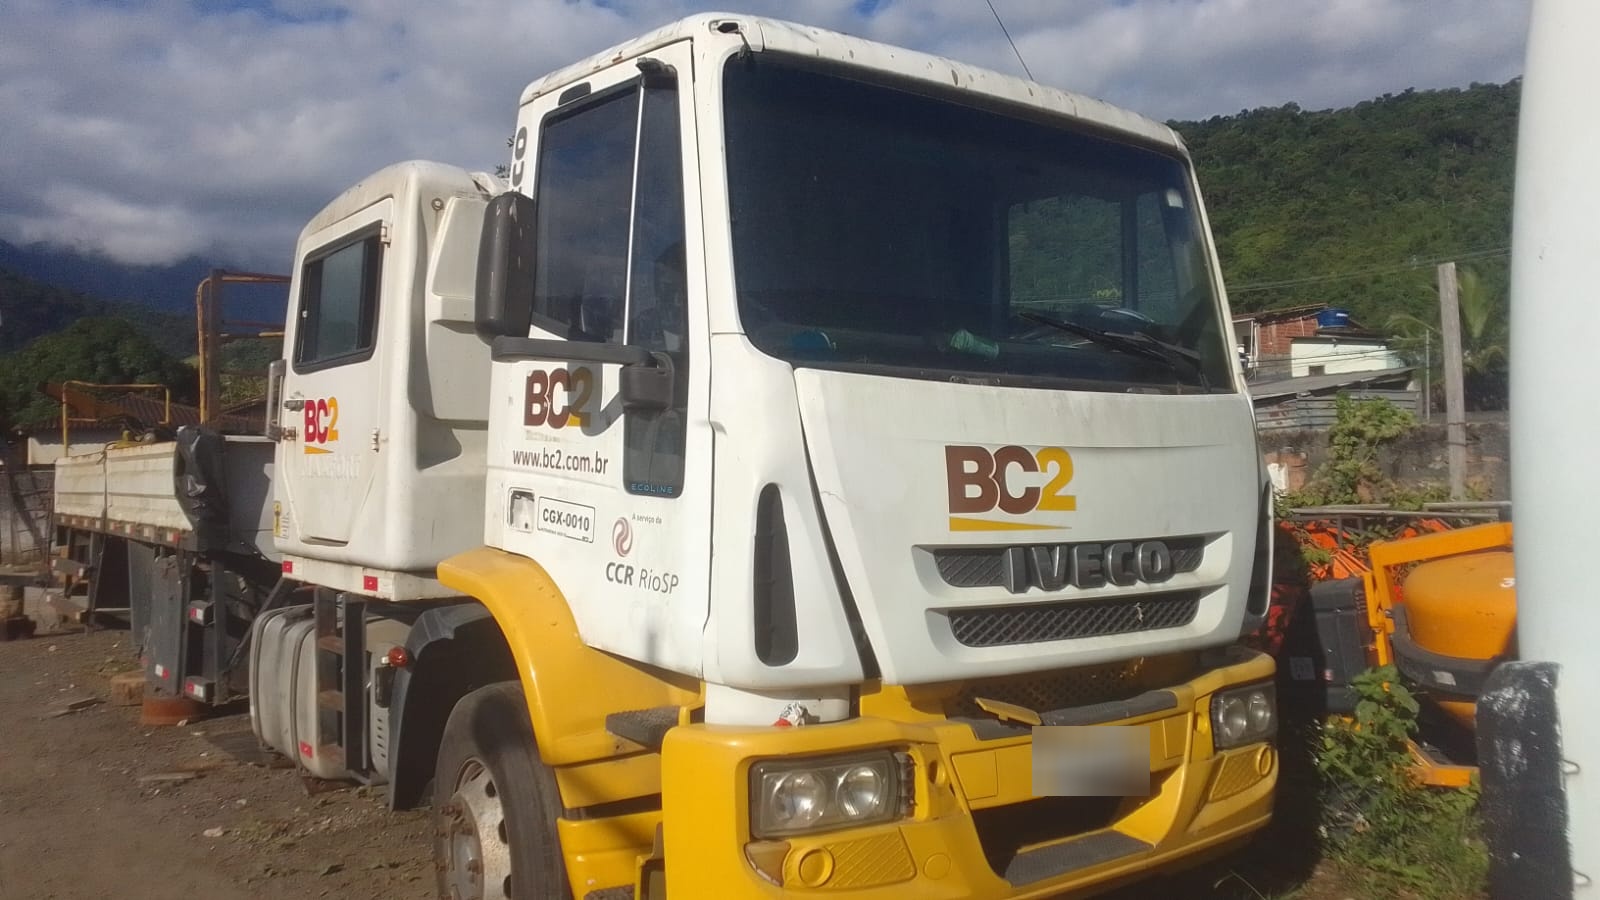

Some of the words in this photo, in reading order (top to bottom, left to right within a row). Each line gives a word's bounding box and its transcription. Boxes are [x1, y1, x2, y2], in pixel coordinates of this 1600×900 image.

[512, 126, 528, 192] CO
[304, 396, 339, 443] BC2
[524, 366, 594, 429] BC2
[512, 447, 609, 475] www.bc2.com.br
[945, 445, 1076, 514] BC2
[631, 483, 673, 494] ECOLINE
[542, 507, 590, 532] CGX-0010
[605, 561, 635, 586] CCR
[639, 568, 679, 595] RioSP
[1003, 541, 1176, 594] IVECO
